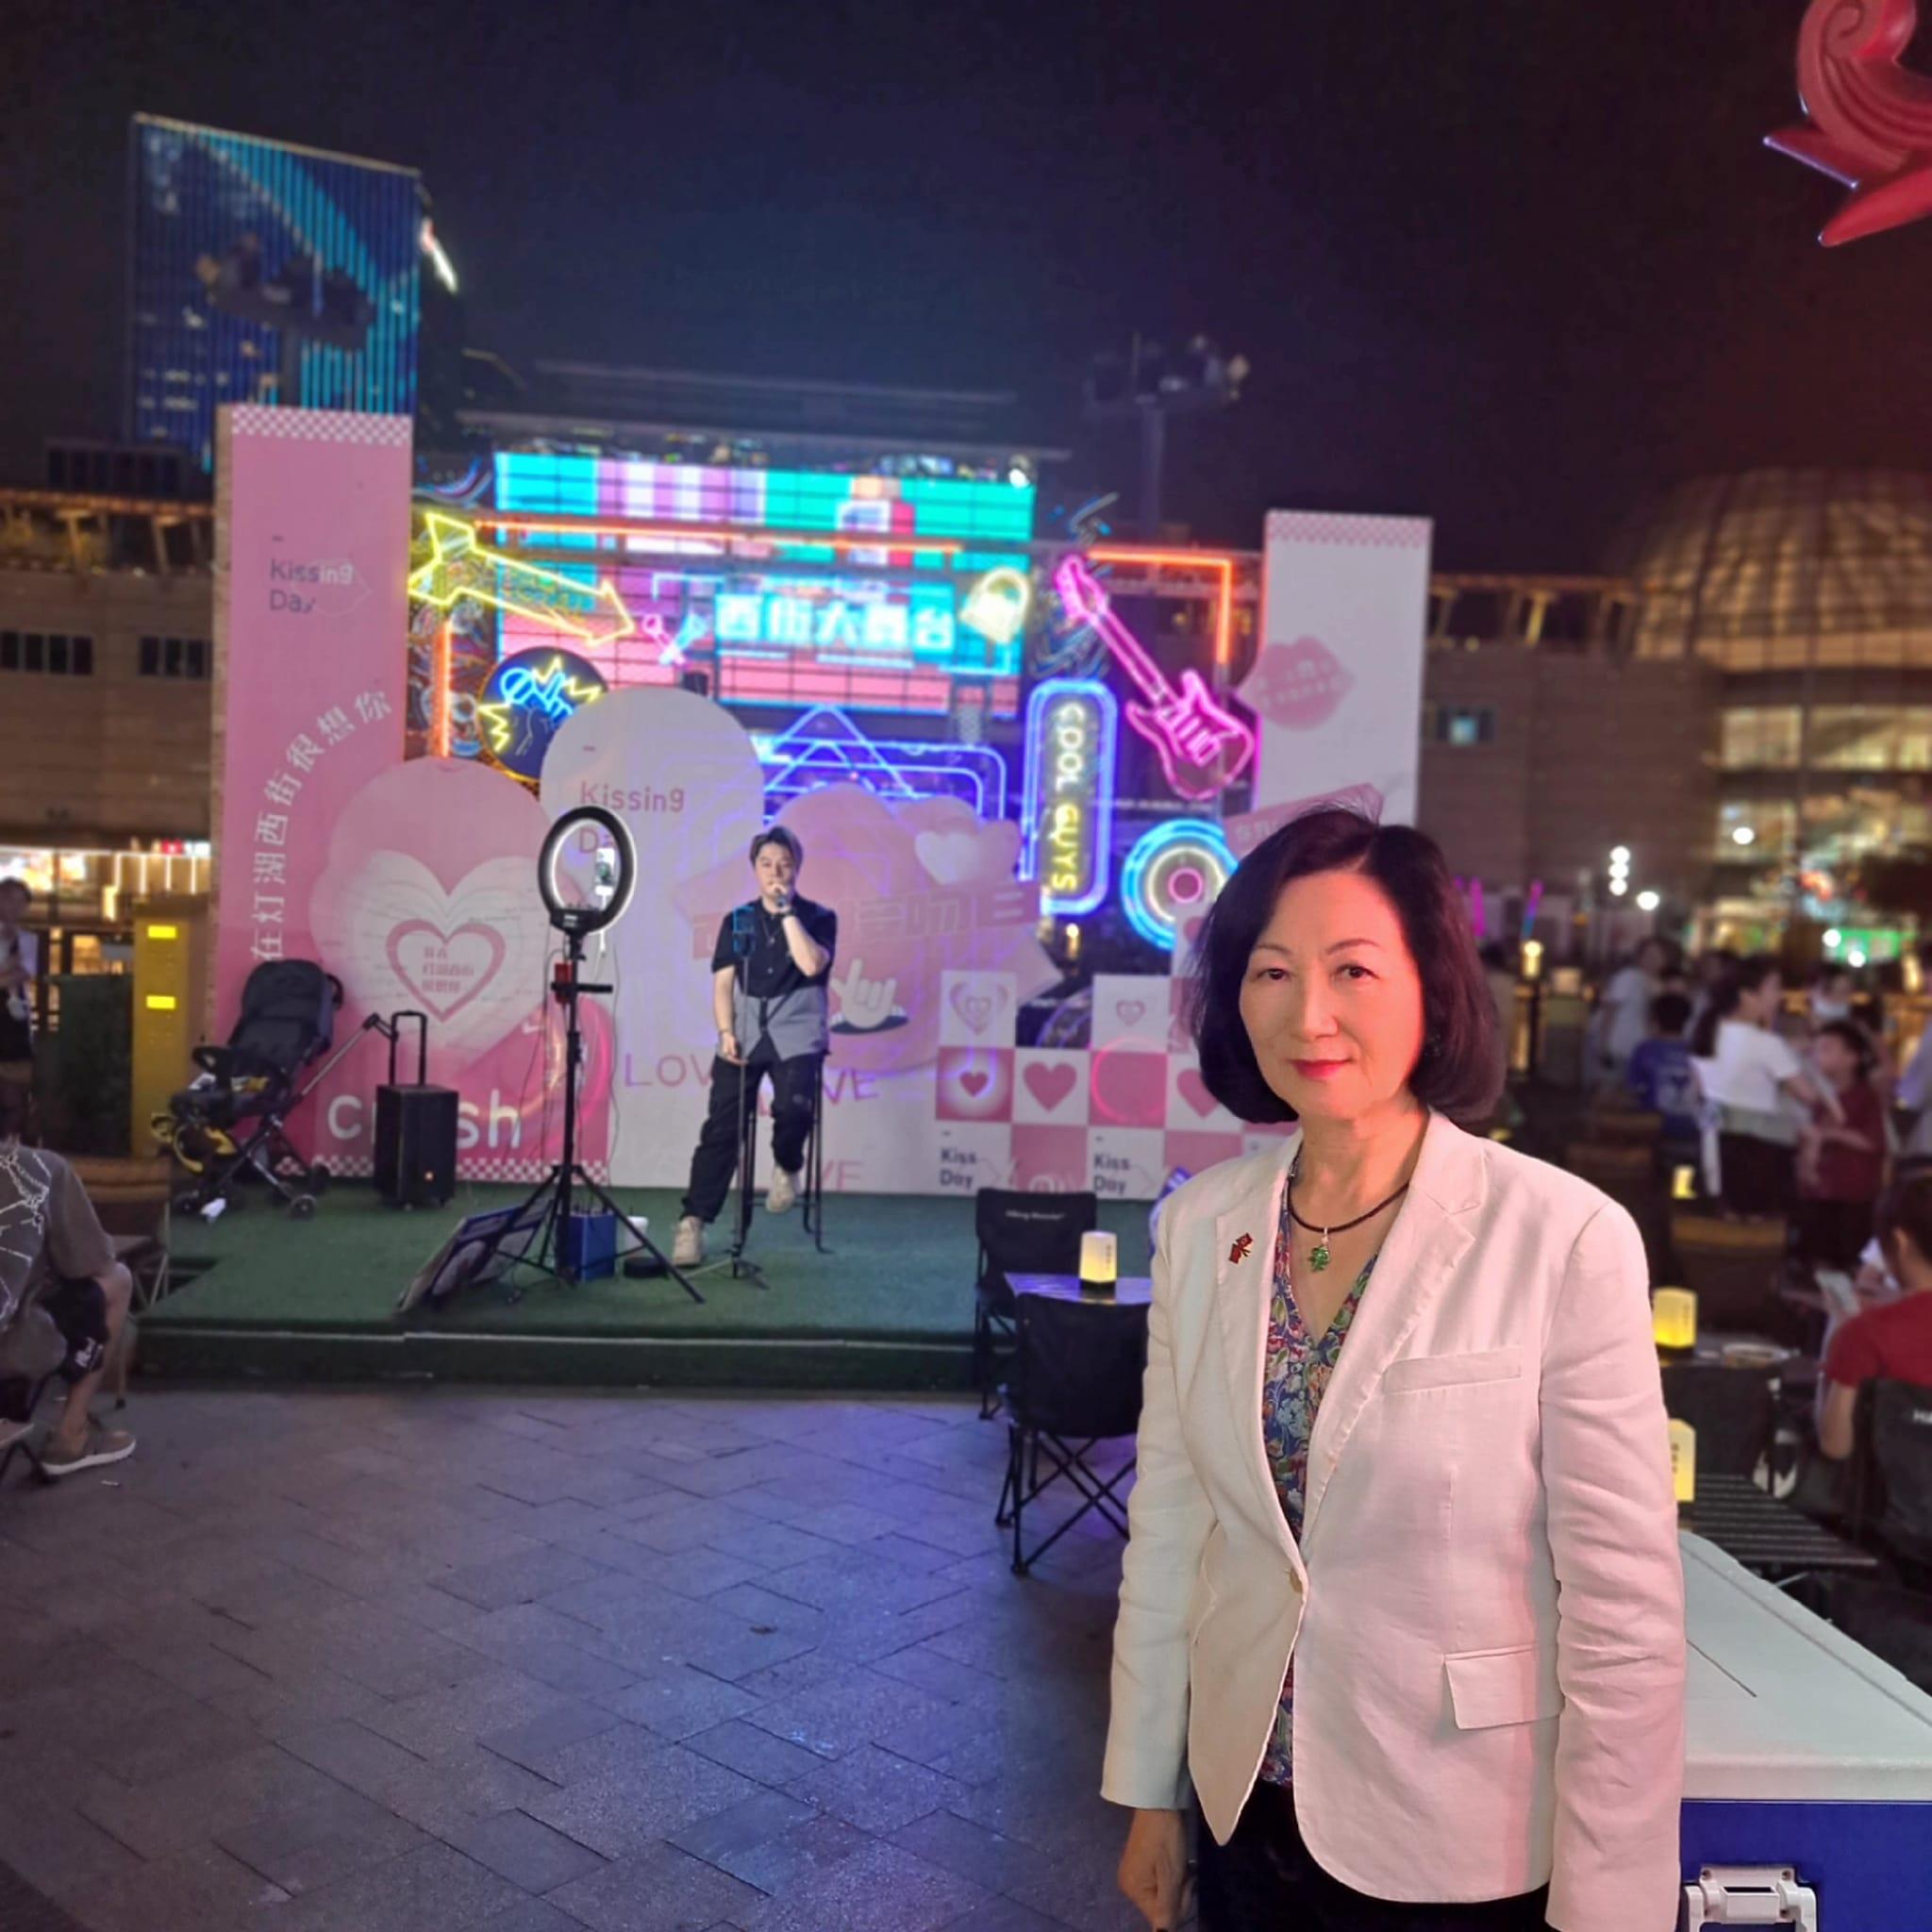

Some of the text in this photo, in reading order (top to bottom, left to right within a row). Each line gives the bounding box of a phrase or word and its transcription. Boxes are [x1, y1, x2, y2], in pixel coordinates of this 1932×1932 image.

[1056, 702, 1085, 791] COOL
[580, 779, 685, 812] Kissing
[941, 1148, 976, 1165] Kiss
[1093, 1154, 1130, 1171] Kiss
[940, 1169, 974, 1189] Day
[1093, 1174, 1126, 1194] Day
